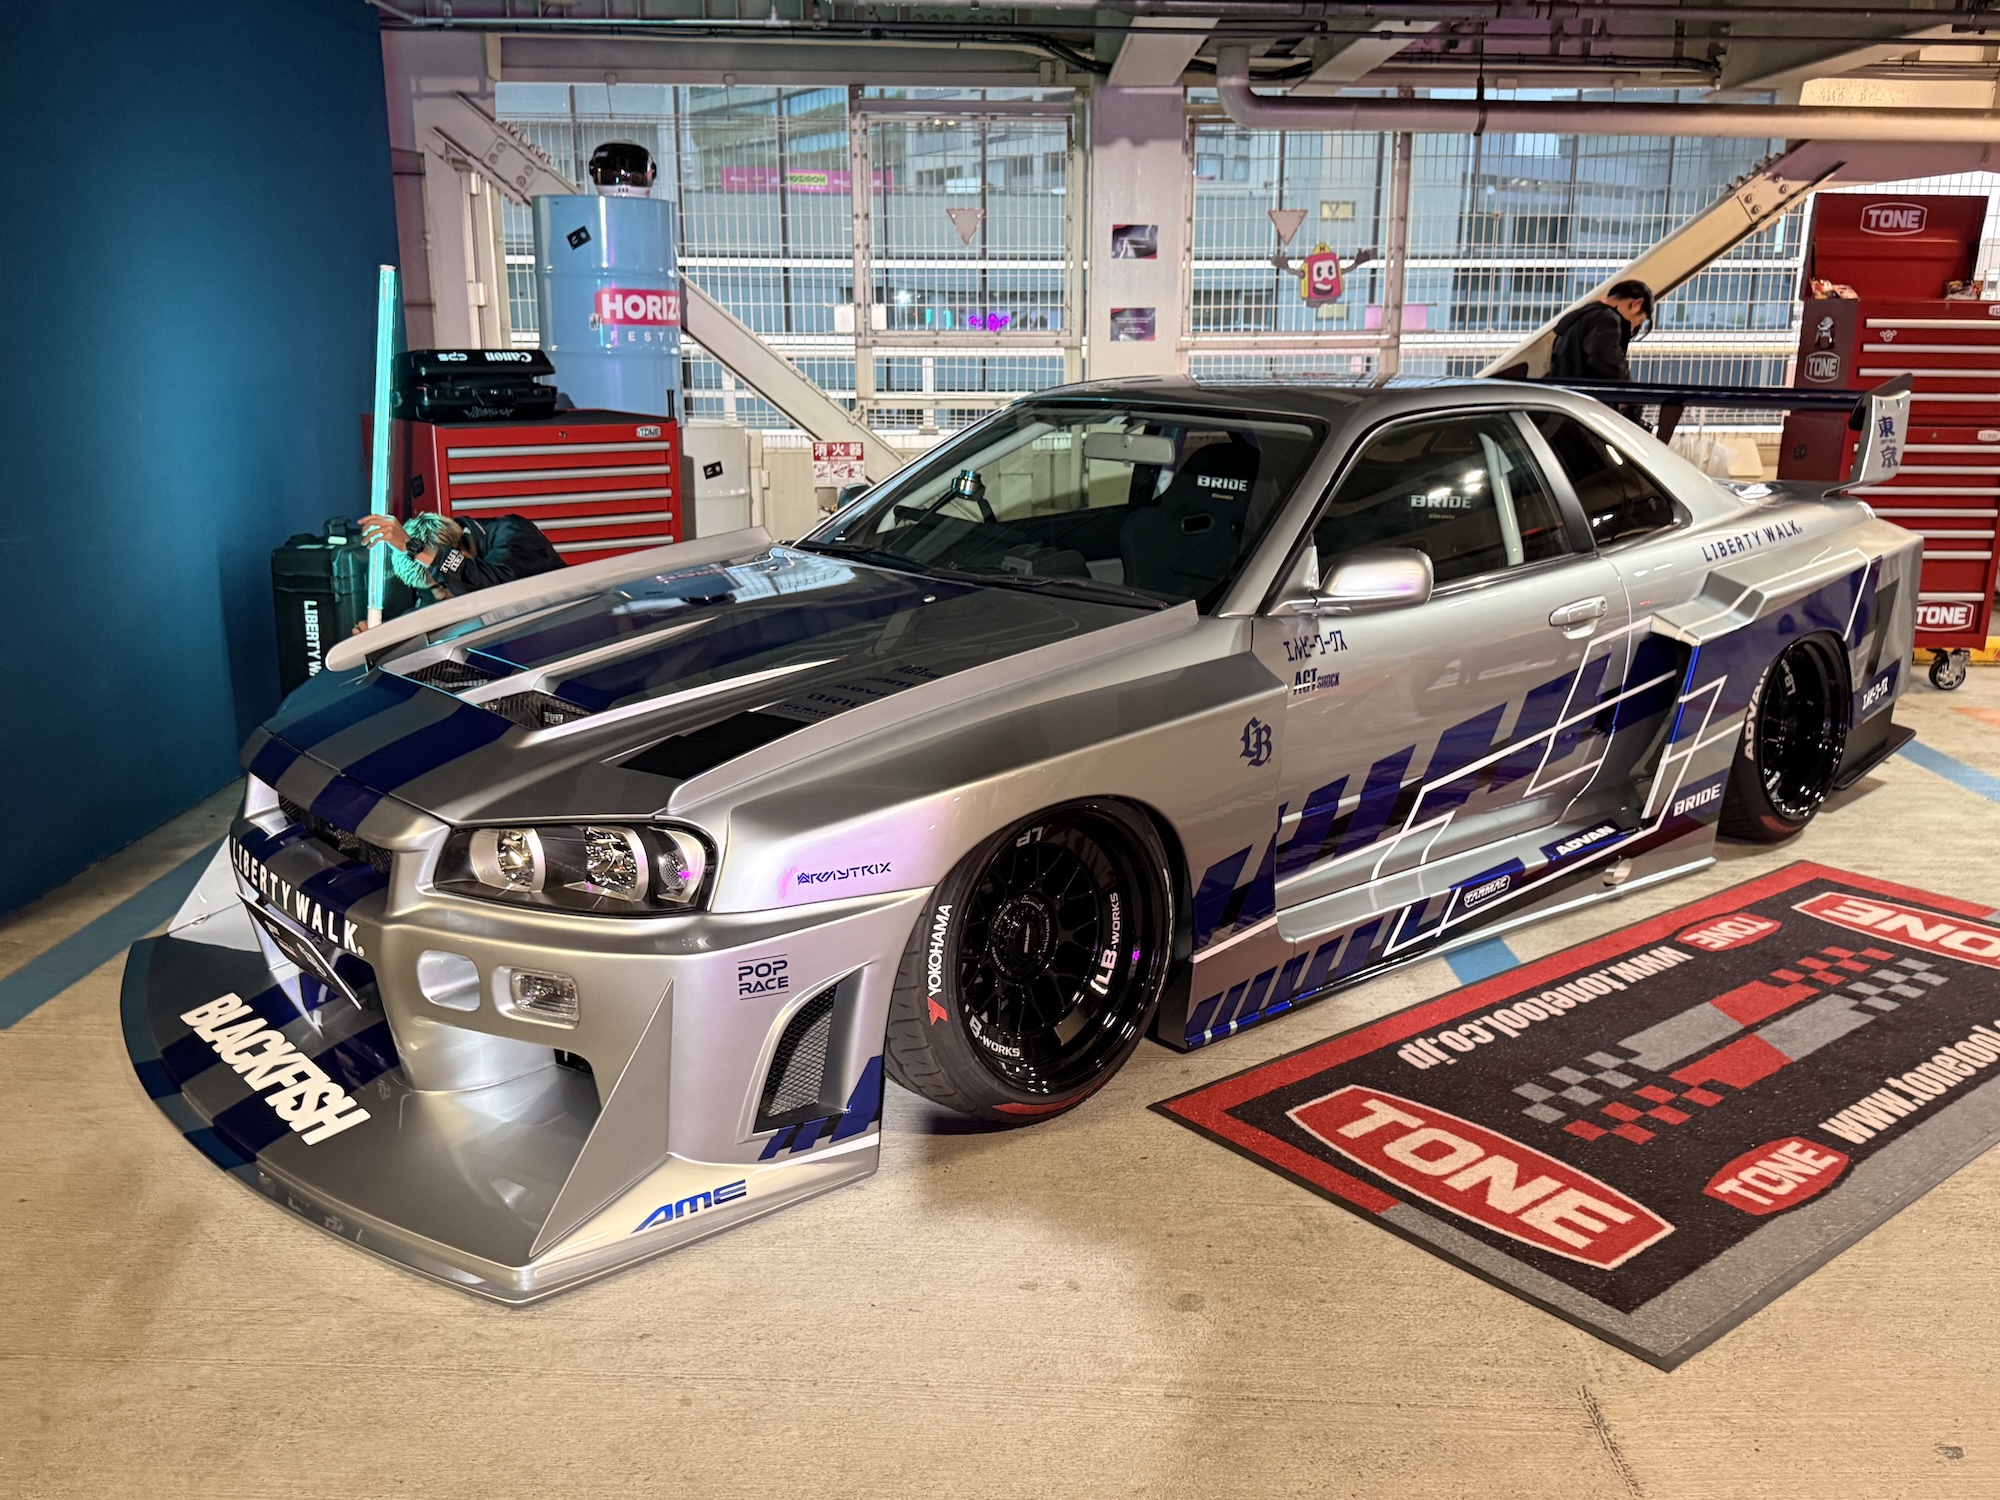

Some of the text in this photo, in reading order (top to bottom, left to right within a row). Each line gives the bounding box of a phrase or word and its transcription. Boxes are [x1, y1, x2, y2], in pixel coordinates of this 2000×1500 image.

[1868, 210, 1921, 228] TONE
[601, 294, 680, 320] HORIZ
[610, 332, 675, 342] FESTI
[485, 352, 532, 363] Canon
[1808, 358, 1838, 377] TONE
[1197, 475, 1248, 492] BRIDE
[1411, 494, 1472, 509] BRIDE
[1702, 530, 1762, 562] LIBERTY
[1917, 606, 1968, 625] TONE
[304, 600, 322, 677] LIBERTY W
[1673, 783, 1722, 817] BRIDE
[1555, 825, 1617, 856] ADVAN
[232, 837, 291, 911] LIBERTY
[1465, 876, 1508, 905] TARMAC
[1095, 892, 1121, 985] LB-WORKS
[1683, 916, 1775, 949] TONE
[1820, 900, 2000, 962] ONE
[928, 904, 953, 997] YOKOHAMA
[738, 960, 788, 981] POP
[739, 976, 789, 995] RACE
[1397, 945, 1695, 1070] www.tonetool.co.jp
[180, 992, 371, 1146] BLACKFISH
[1818, 1020, 2000, 1145] www.tonetool
[1337, 1098, 1635, 1250] TONE
[1714, 1140, 1841, 1206] TONE
[630, 1179, 747, 1234] AME
